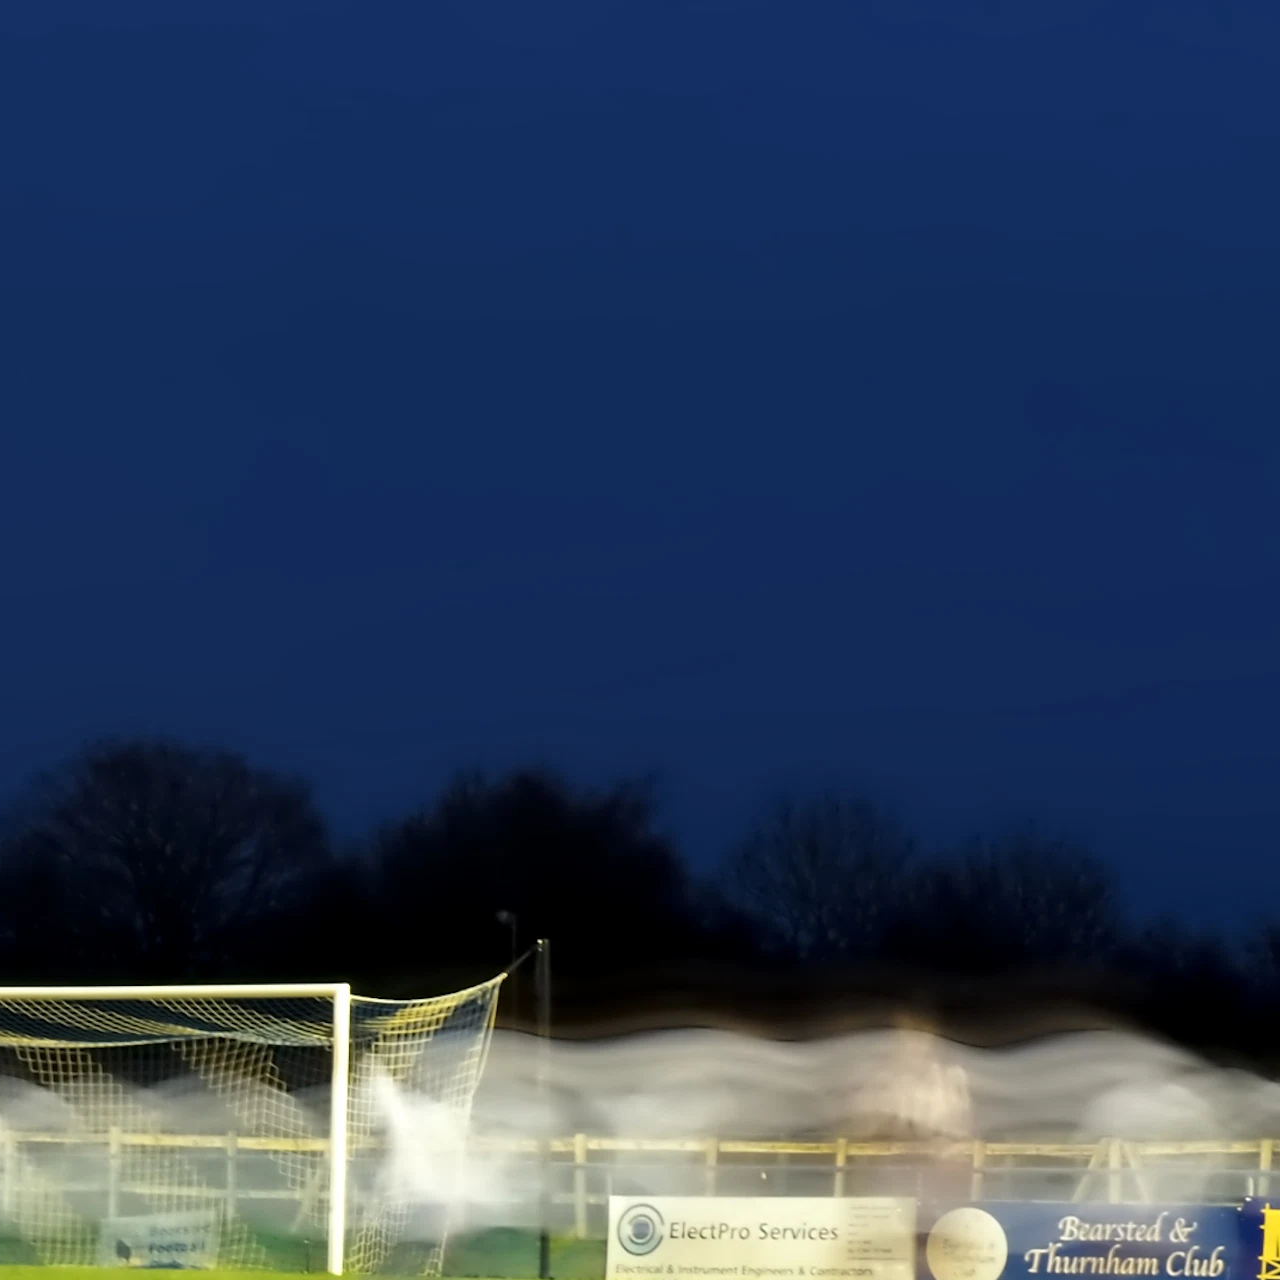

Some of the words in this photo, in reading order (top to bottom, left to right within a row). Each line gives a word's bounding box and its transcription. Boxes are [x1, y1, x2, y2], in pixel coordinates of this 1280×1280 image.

[669, 1221, 750, 1240] ElectPro
[758, 1222, 838, 1241] Services
[1058, 1211, 1169, 1242] Bearsted
[1169, 1217, 1198, 1243] &
[615, 1263, 663, 1274] Electrical
[666, 1264, 674, 1274] &
[679, 1264, 738, 1275] Instrument
[741, 1265, 793, 1277] Engineers
[798, 1266, 804, 1276] &
[810, 1266, 873, 1277] Contractors
[1024, 1242, 1160, 1276] Thurnham
[1166, 1245, 1225, 1278] Club
